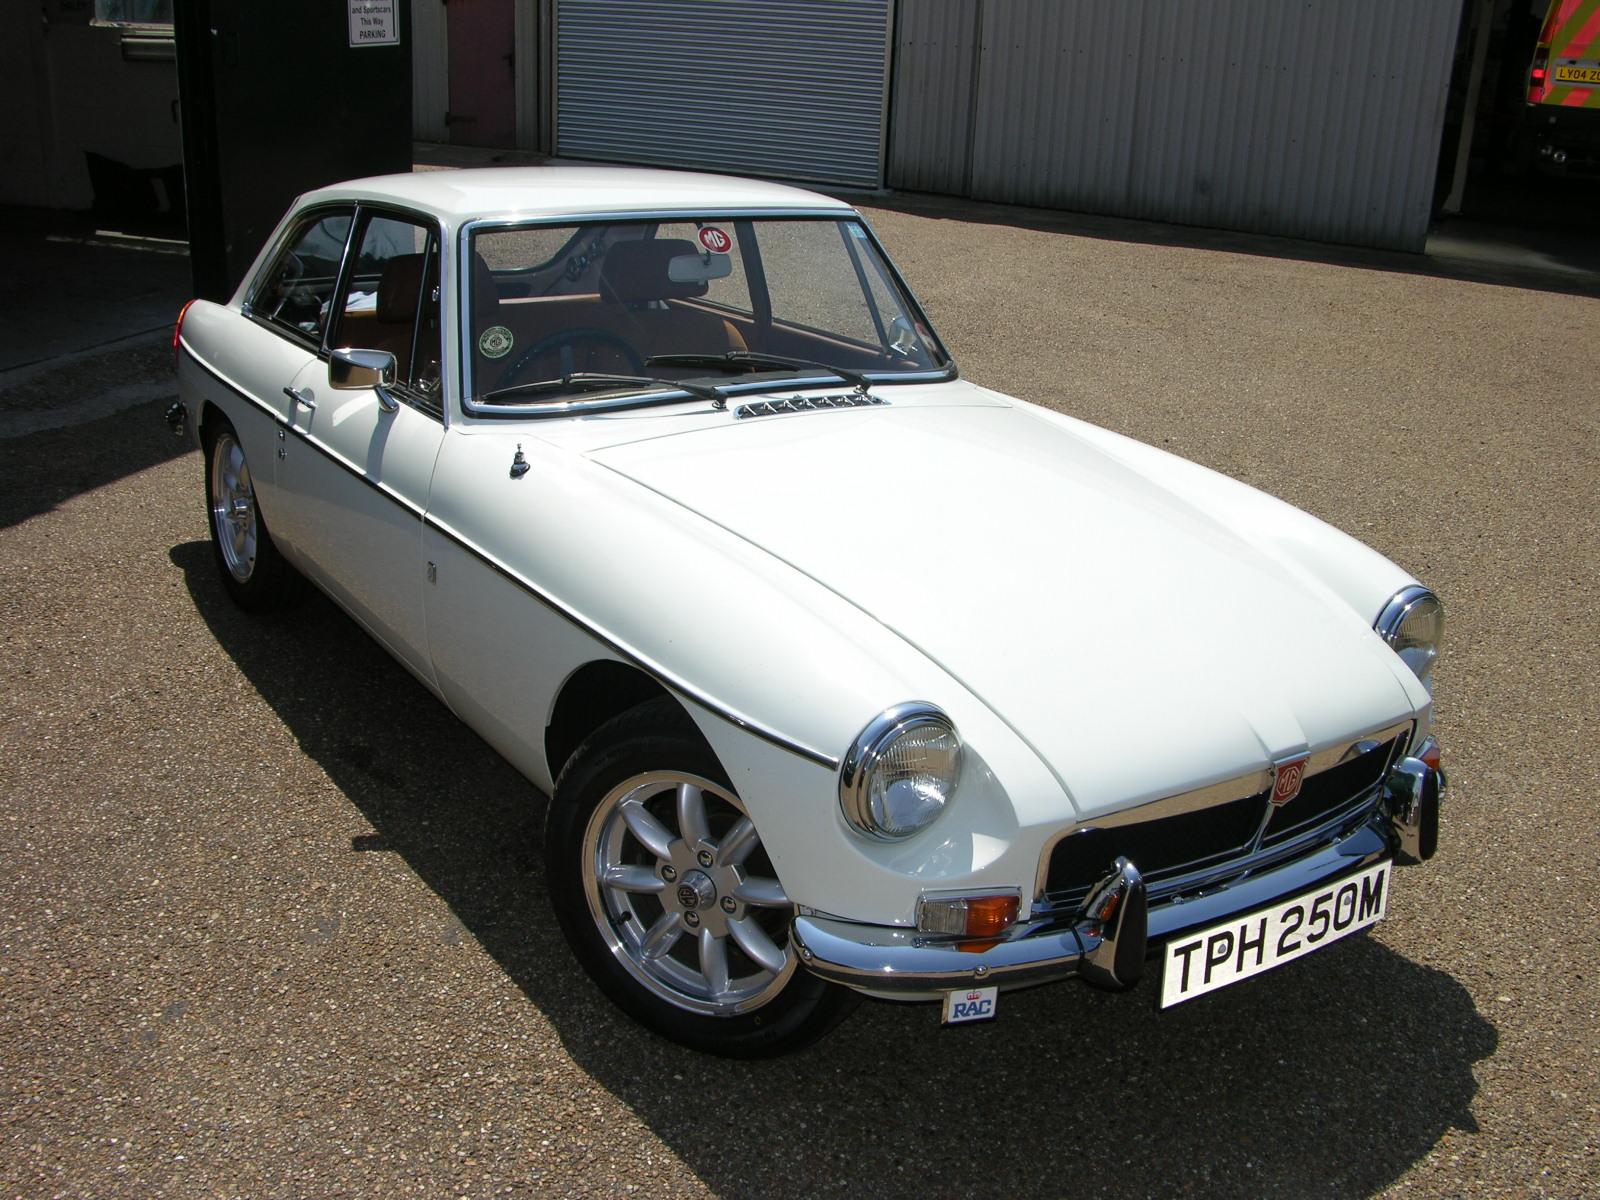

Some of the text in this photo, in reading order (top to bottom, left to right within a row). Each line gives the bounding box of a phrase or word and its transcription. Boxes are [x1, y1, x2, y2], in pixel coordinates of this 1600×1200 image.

[352, 6, 362, 14] and
[360, 17, 384, 27] This Way
[359, 30, 386, 39] PARKING
[1559, 68, 1587, 79] LY04
[703, 230, 726, 248] MG
[1278, 768, 1299, 794] MG
[1174, 869, 1385, 993] TPH 250M
[952, 999, 992, 1019] RAC
